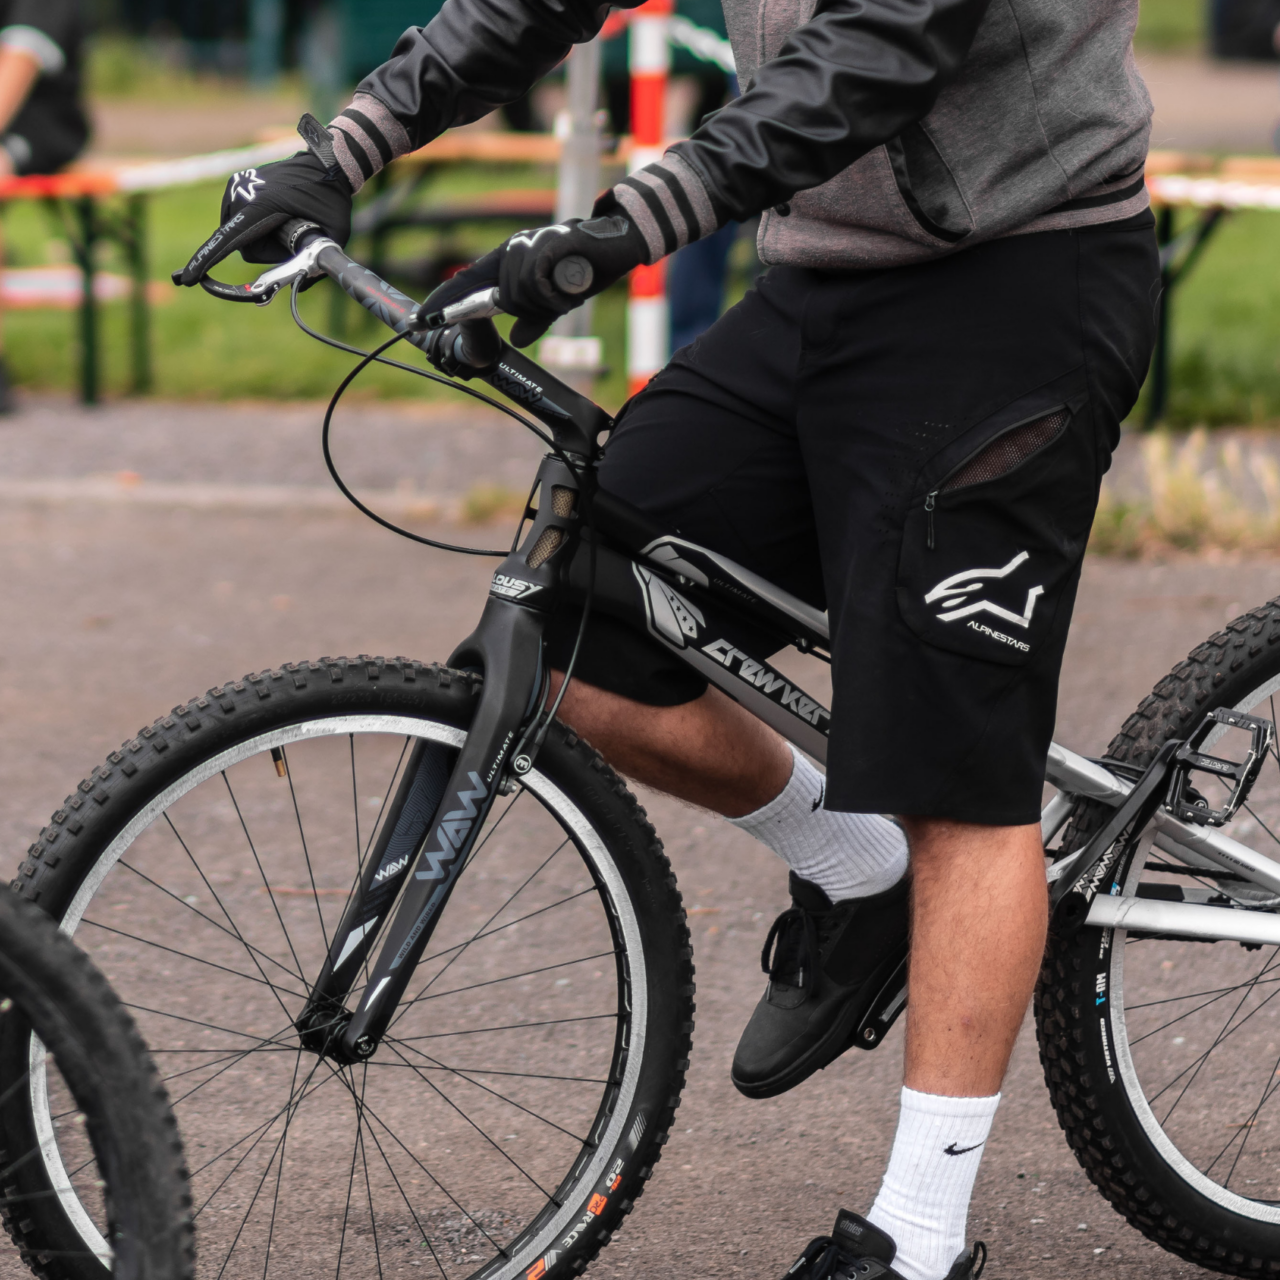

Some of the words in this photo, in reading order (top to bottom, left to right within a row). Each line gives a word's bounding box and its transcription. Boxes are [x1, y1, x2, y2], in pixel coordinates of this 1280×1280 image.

[499, 362, 543, 393] ULTIMATE
[713, 578, 758, 603] ULTIMATE
[967, 620, 1030, 652] ALPINESTARS
[486, 731, 514, 782] ULTIMATE
[415, 771, 488, 881] WAW
[375, 854, 409, 881] WAW
[398, 941, 412, 959] WILD
[410, 925, 422, 941] AND
[420, 902, 436, 925] WIRED
